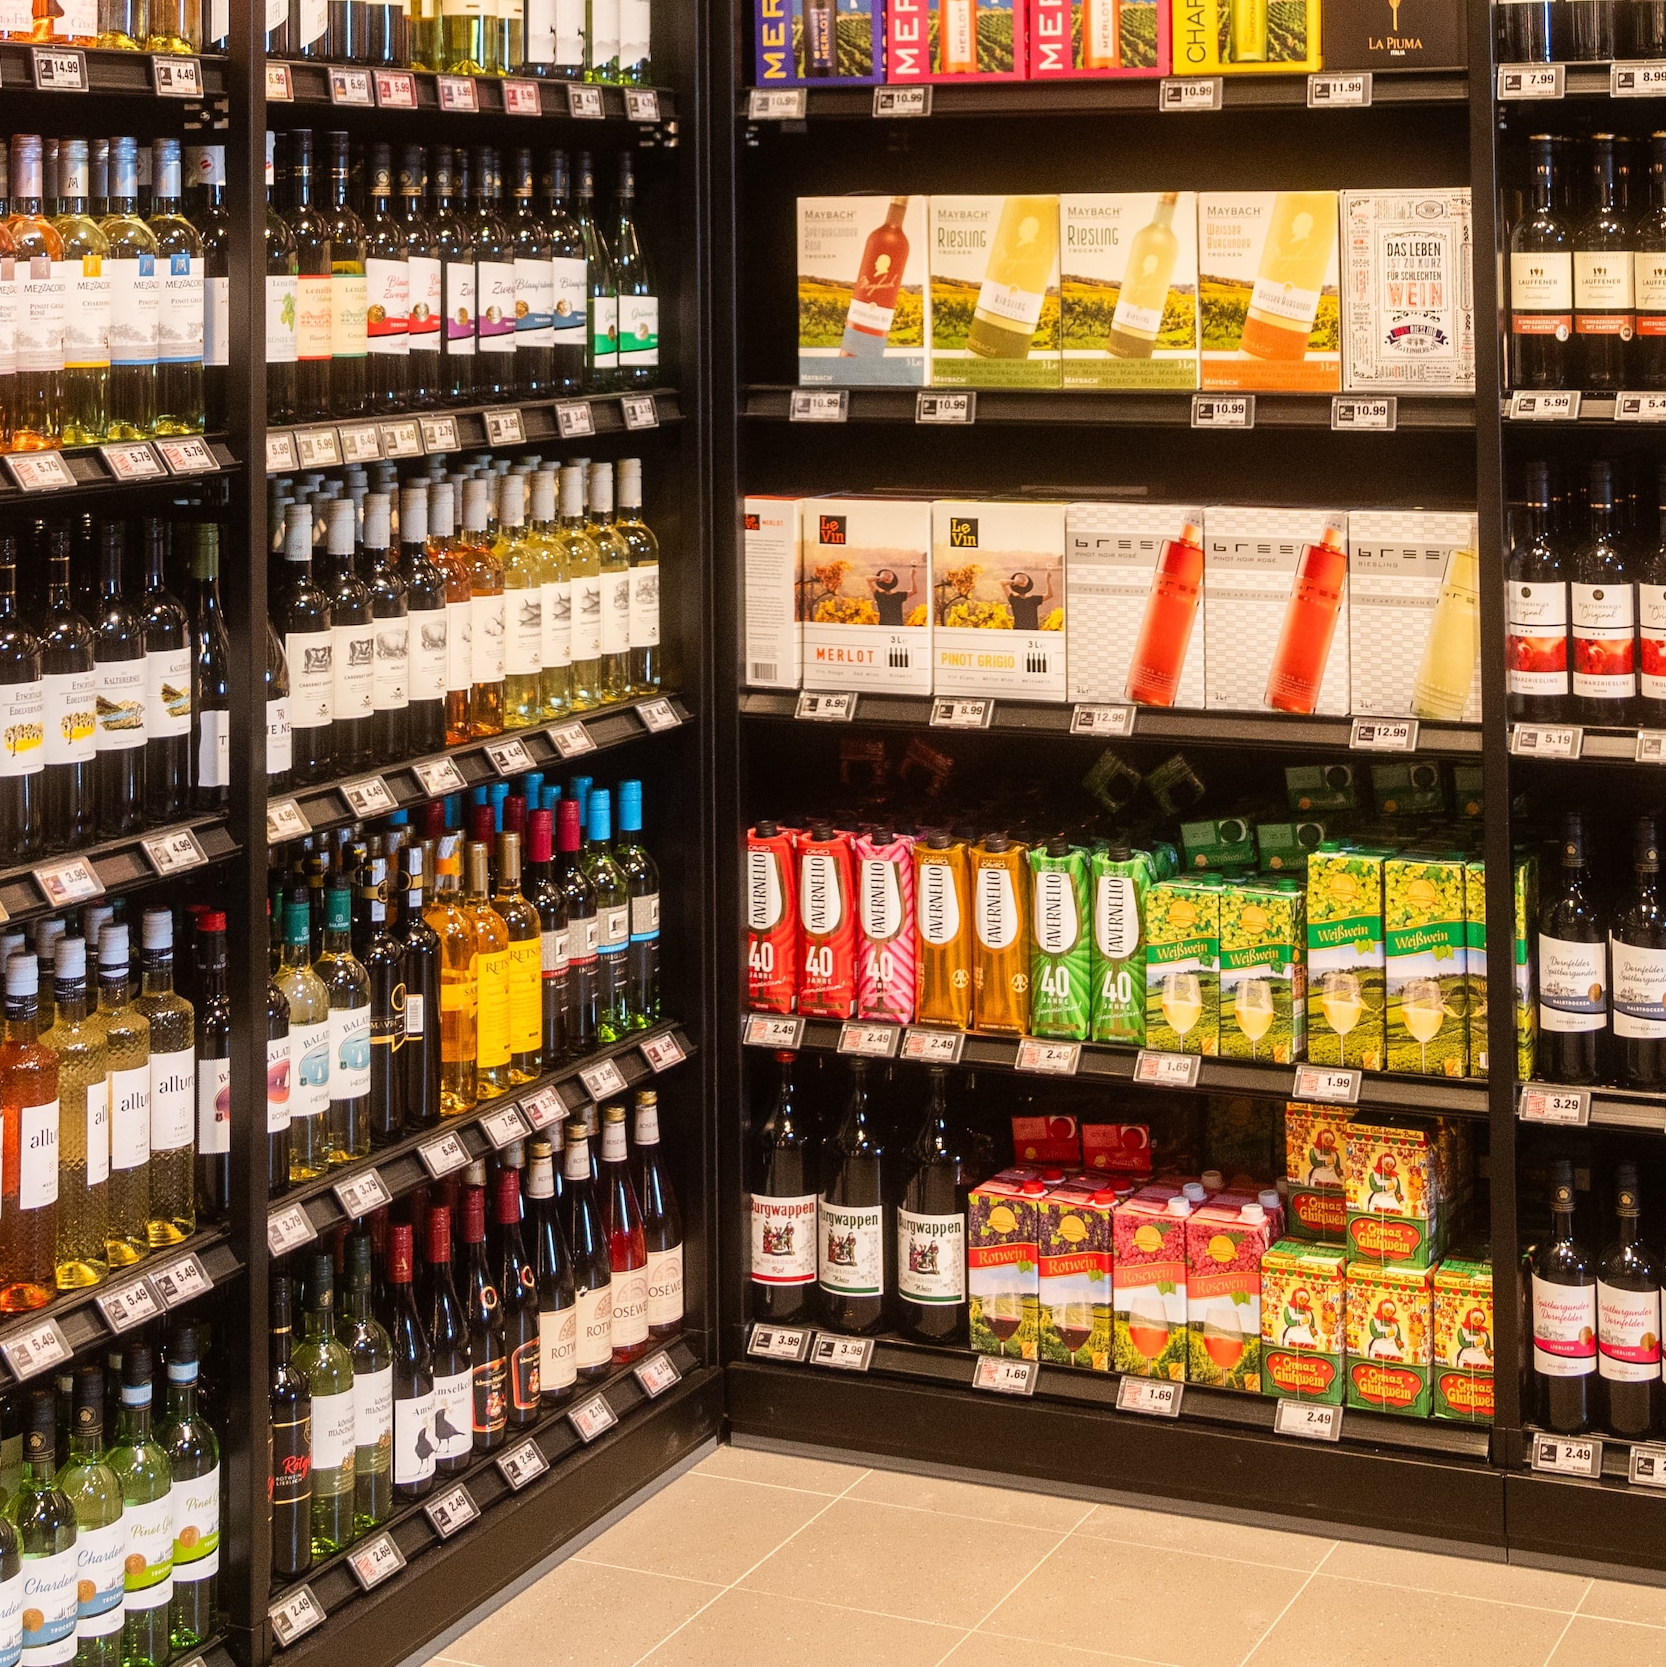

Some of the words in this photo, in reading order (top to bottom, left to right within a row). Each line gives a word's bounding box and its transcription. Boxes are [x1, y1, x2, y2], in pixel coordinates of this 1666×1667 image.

[1368, 37, 1384, 50] LA
[1386, 36, 1422, 50] PIUMA
[54, 60, 78, 73] 14.99
[177, 69, 194, 81] 4.49
[350, 79, 366, 90] 6.99
[457, 85, 471, 97] 5.99
[1332, 83, 1361, 93] 11.99
[895, 94, 922, 103] 10.99
[1207, 206, 1261, 216] MAYBACH
[1387, 242, 1407, 258] DAS
[1409, 242, 1441, 257] LEBEN
[1387, 258, 1400, 269] IST
[1404, 257, 1415, 268] ZU
[1418, 257, 1441, 268] KURZ
[1387, 269, 1398, 280] FÜR
[1400, 270, 1441, 280] SCHLECHTEN
[1387, 282, 1443, 309] WEIN
[1215, 404, 1244, 414] 10.99
[184, 445, 204, 458] 5.79
[821, 516, 839, 531] Le
[821, 530, 845, 544] Vin
[1358, 561, 1398, 569] RIESLING
[816, 647, 874, 663] MERLOT
[941, 652, 973, 666] PINOT
[977, 653, 1015, 669] GRIGIO
[1376, 727, 1406, 738] 12.99
[365, 786, 383, 799] 4.49
[811, 857, 825, 930] TAVERNELLO
[929, 867, 944, 940] TAVERNELLO
[1046, 874, 1062, 949] TAVERNELLO
[1317, 924, 1369, 944] Weißwein
[1157, 941, 1208, 960] Weißwein
[805, 946, 833, 977] 40
[1041, 965, 1070, 997] 40
[773, 1024, 794, 1034] 2.49
[931, 1040, 953, 1050] 2.49
[1326, 1077, 1350, 1088] 1.99
[1553, 1098, 1579, 1110] 3.29
[441, 1142, 458, 1156] 6.99
[979, 1248, 1027, 1265] Rotwein
[1123, 1267, 1174, 1284] Roséwein
[126, 1290, 148, 1308] 5.49
[1282, 1357, 1317, 1373] Omas
[1273, 1368, 1325, 1388] Glühwein
[1307, 1413, 1331, 1424] 2.49
